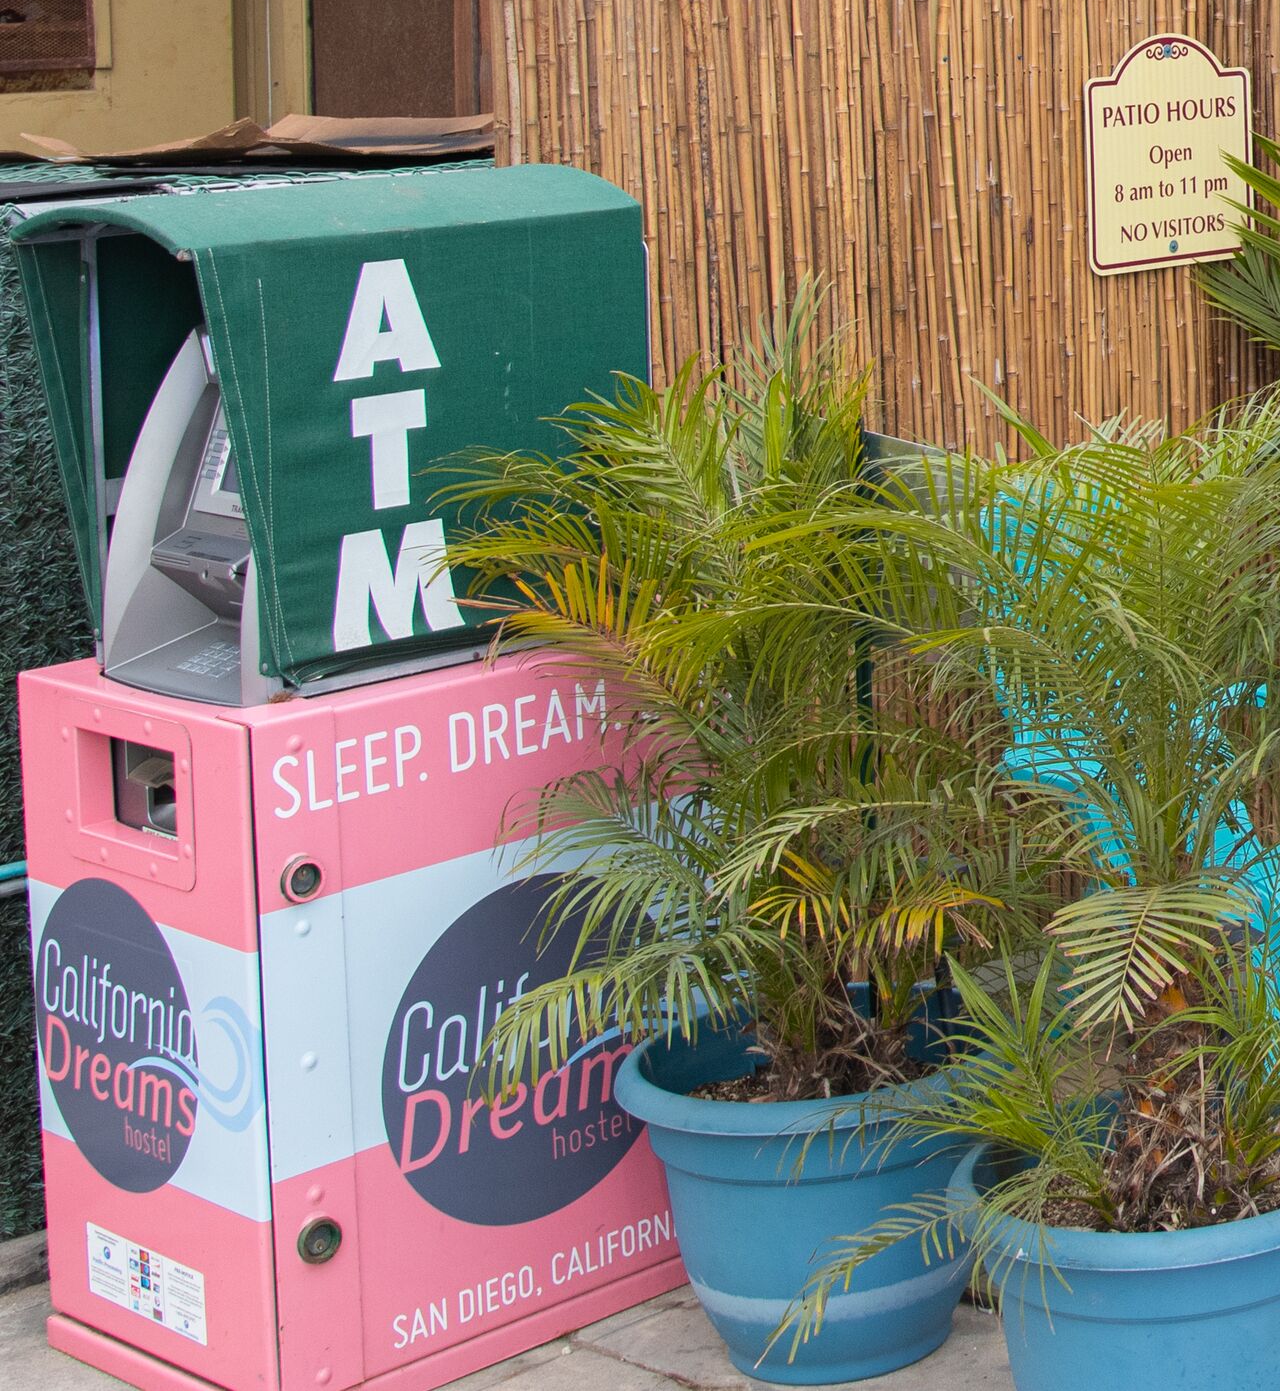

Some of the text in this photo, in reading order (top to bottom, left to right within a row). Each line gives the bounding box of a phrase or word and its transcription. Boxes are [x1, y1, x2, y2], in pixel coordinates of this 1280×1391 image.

[1103, 96, 1236, 128] PATIO HOURS
[1114, 176, 1228, 203] 8 am to 11 pm
[1149, 145, 1193, 169] Open
[1121, 213, 1225, 244] NO VISITORS
[333, 259, 466, 653] ATM
[272, 725, 428, 819] SLEEP.
[448, 678, 622, 773] DREAM.
[43, 938, 199, 1066] California
[45, 1013, 198, 1137] Dreams
[401, 1043, 635, 1174] Dream
[124, 1115, 171, 1164] hostel
[552, 1110, 632, 1160] hostel
[392, 1210, 678, 1349] SAN DIEGO, CALIFORN
